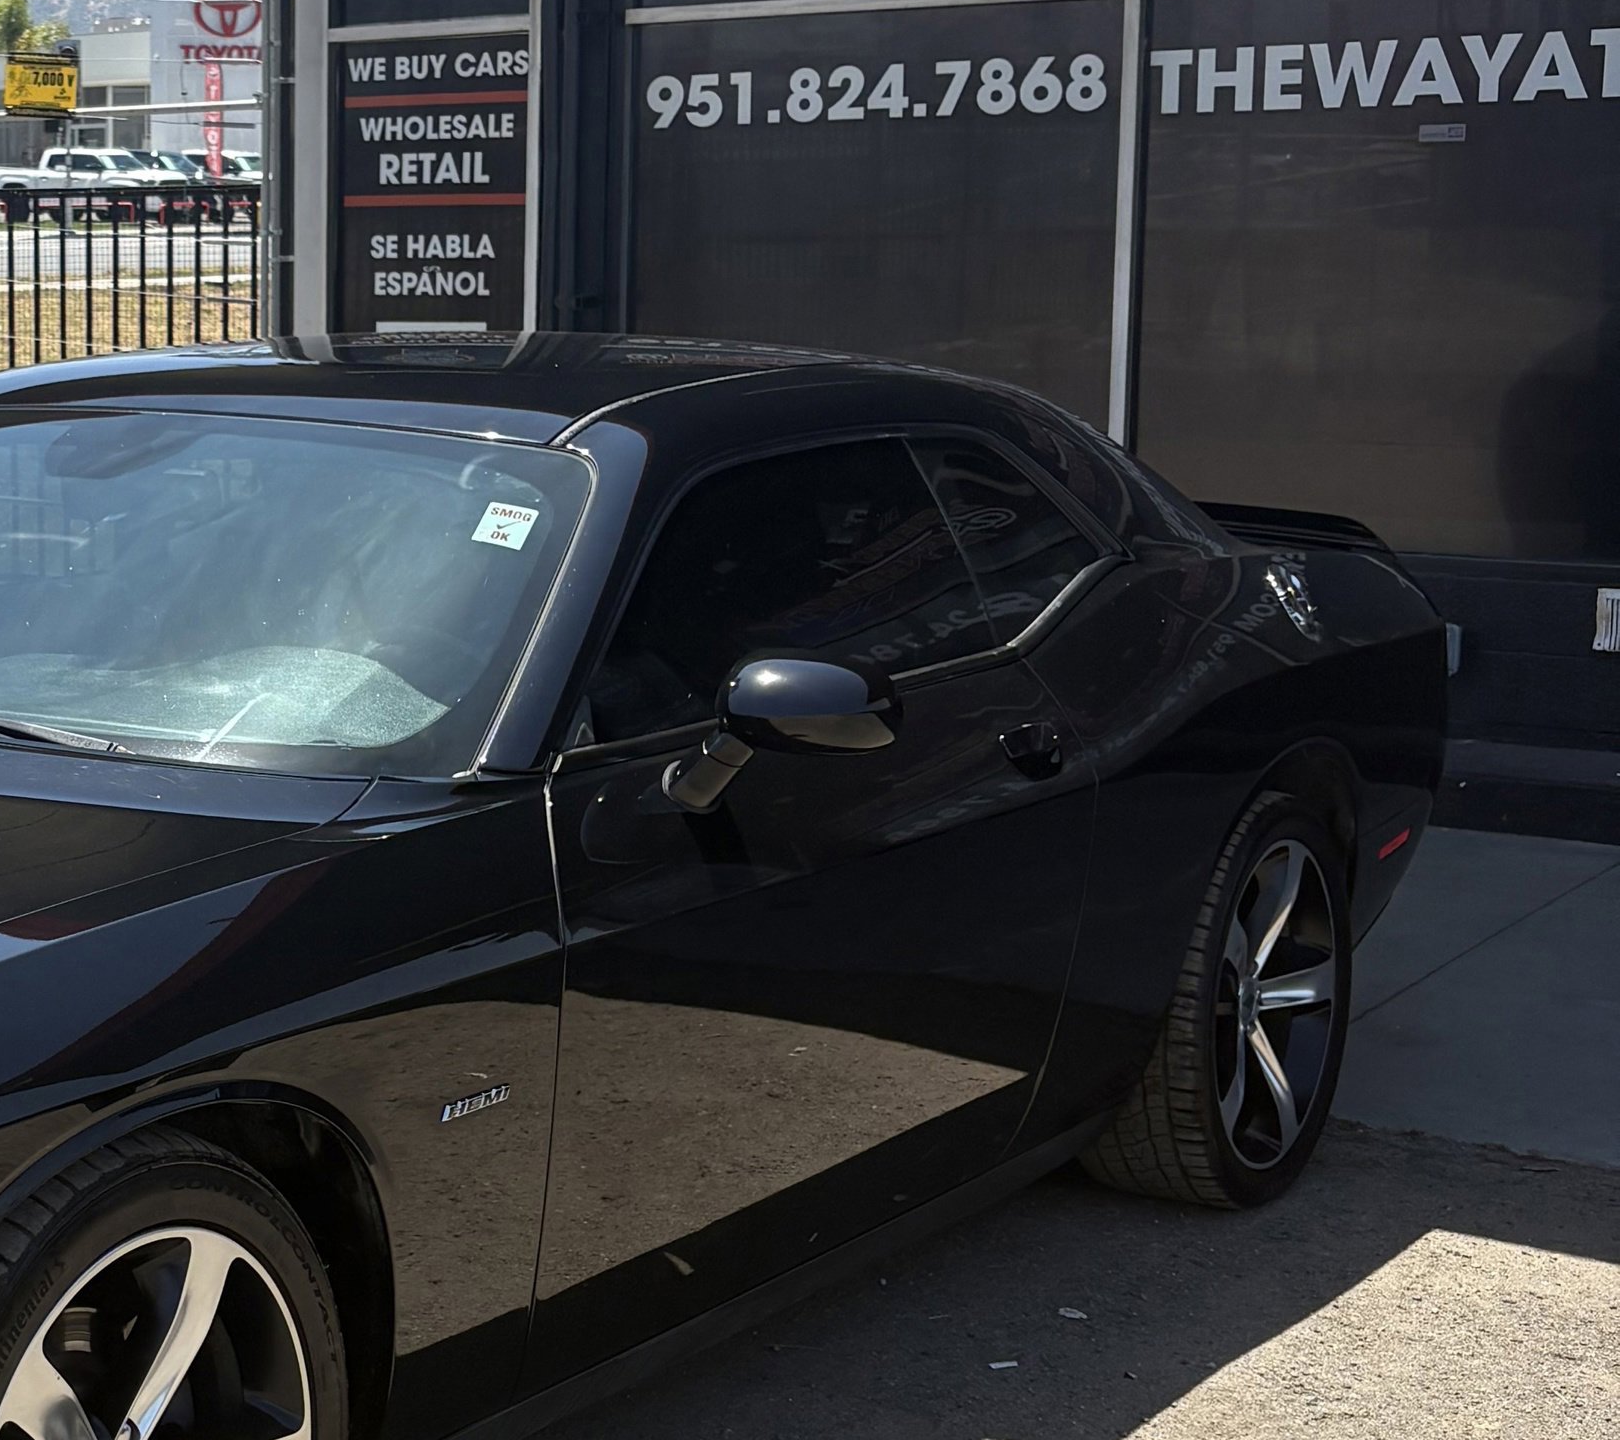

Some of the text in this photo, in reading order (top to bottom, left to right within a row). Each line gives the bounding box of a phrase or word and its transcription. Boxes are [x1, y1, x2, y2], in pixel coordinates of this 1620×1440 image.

[179, 44, 262, 65] TOYOT
[348, 50, 529, 82] WE BUY CARS
[32, 71, 75, 87] 7,000 V
[646, 53, 1108, 130] 951.824.7868
[359, 113, 514, 142] WHOLESALE
[379, 151, 490, 185] RETAIL
[370, 234, 495, 259] SE HABLA
[374, 265, 490, 296] ESPAÑOL
[490, 507, 532, 522] SMOG
[490, 530, 510, 542] OK
